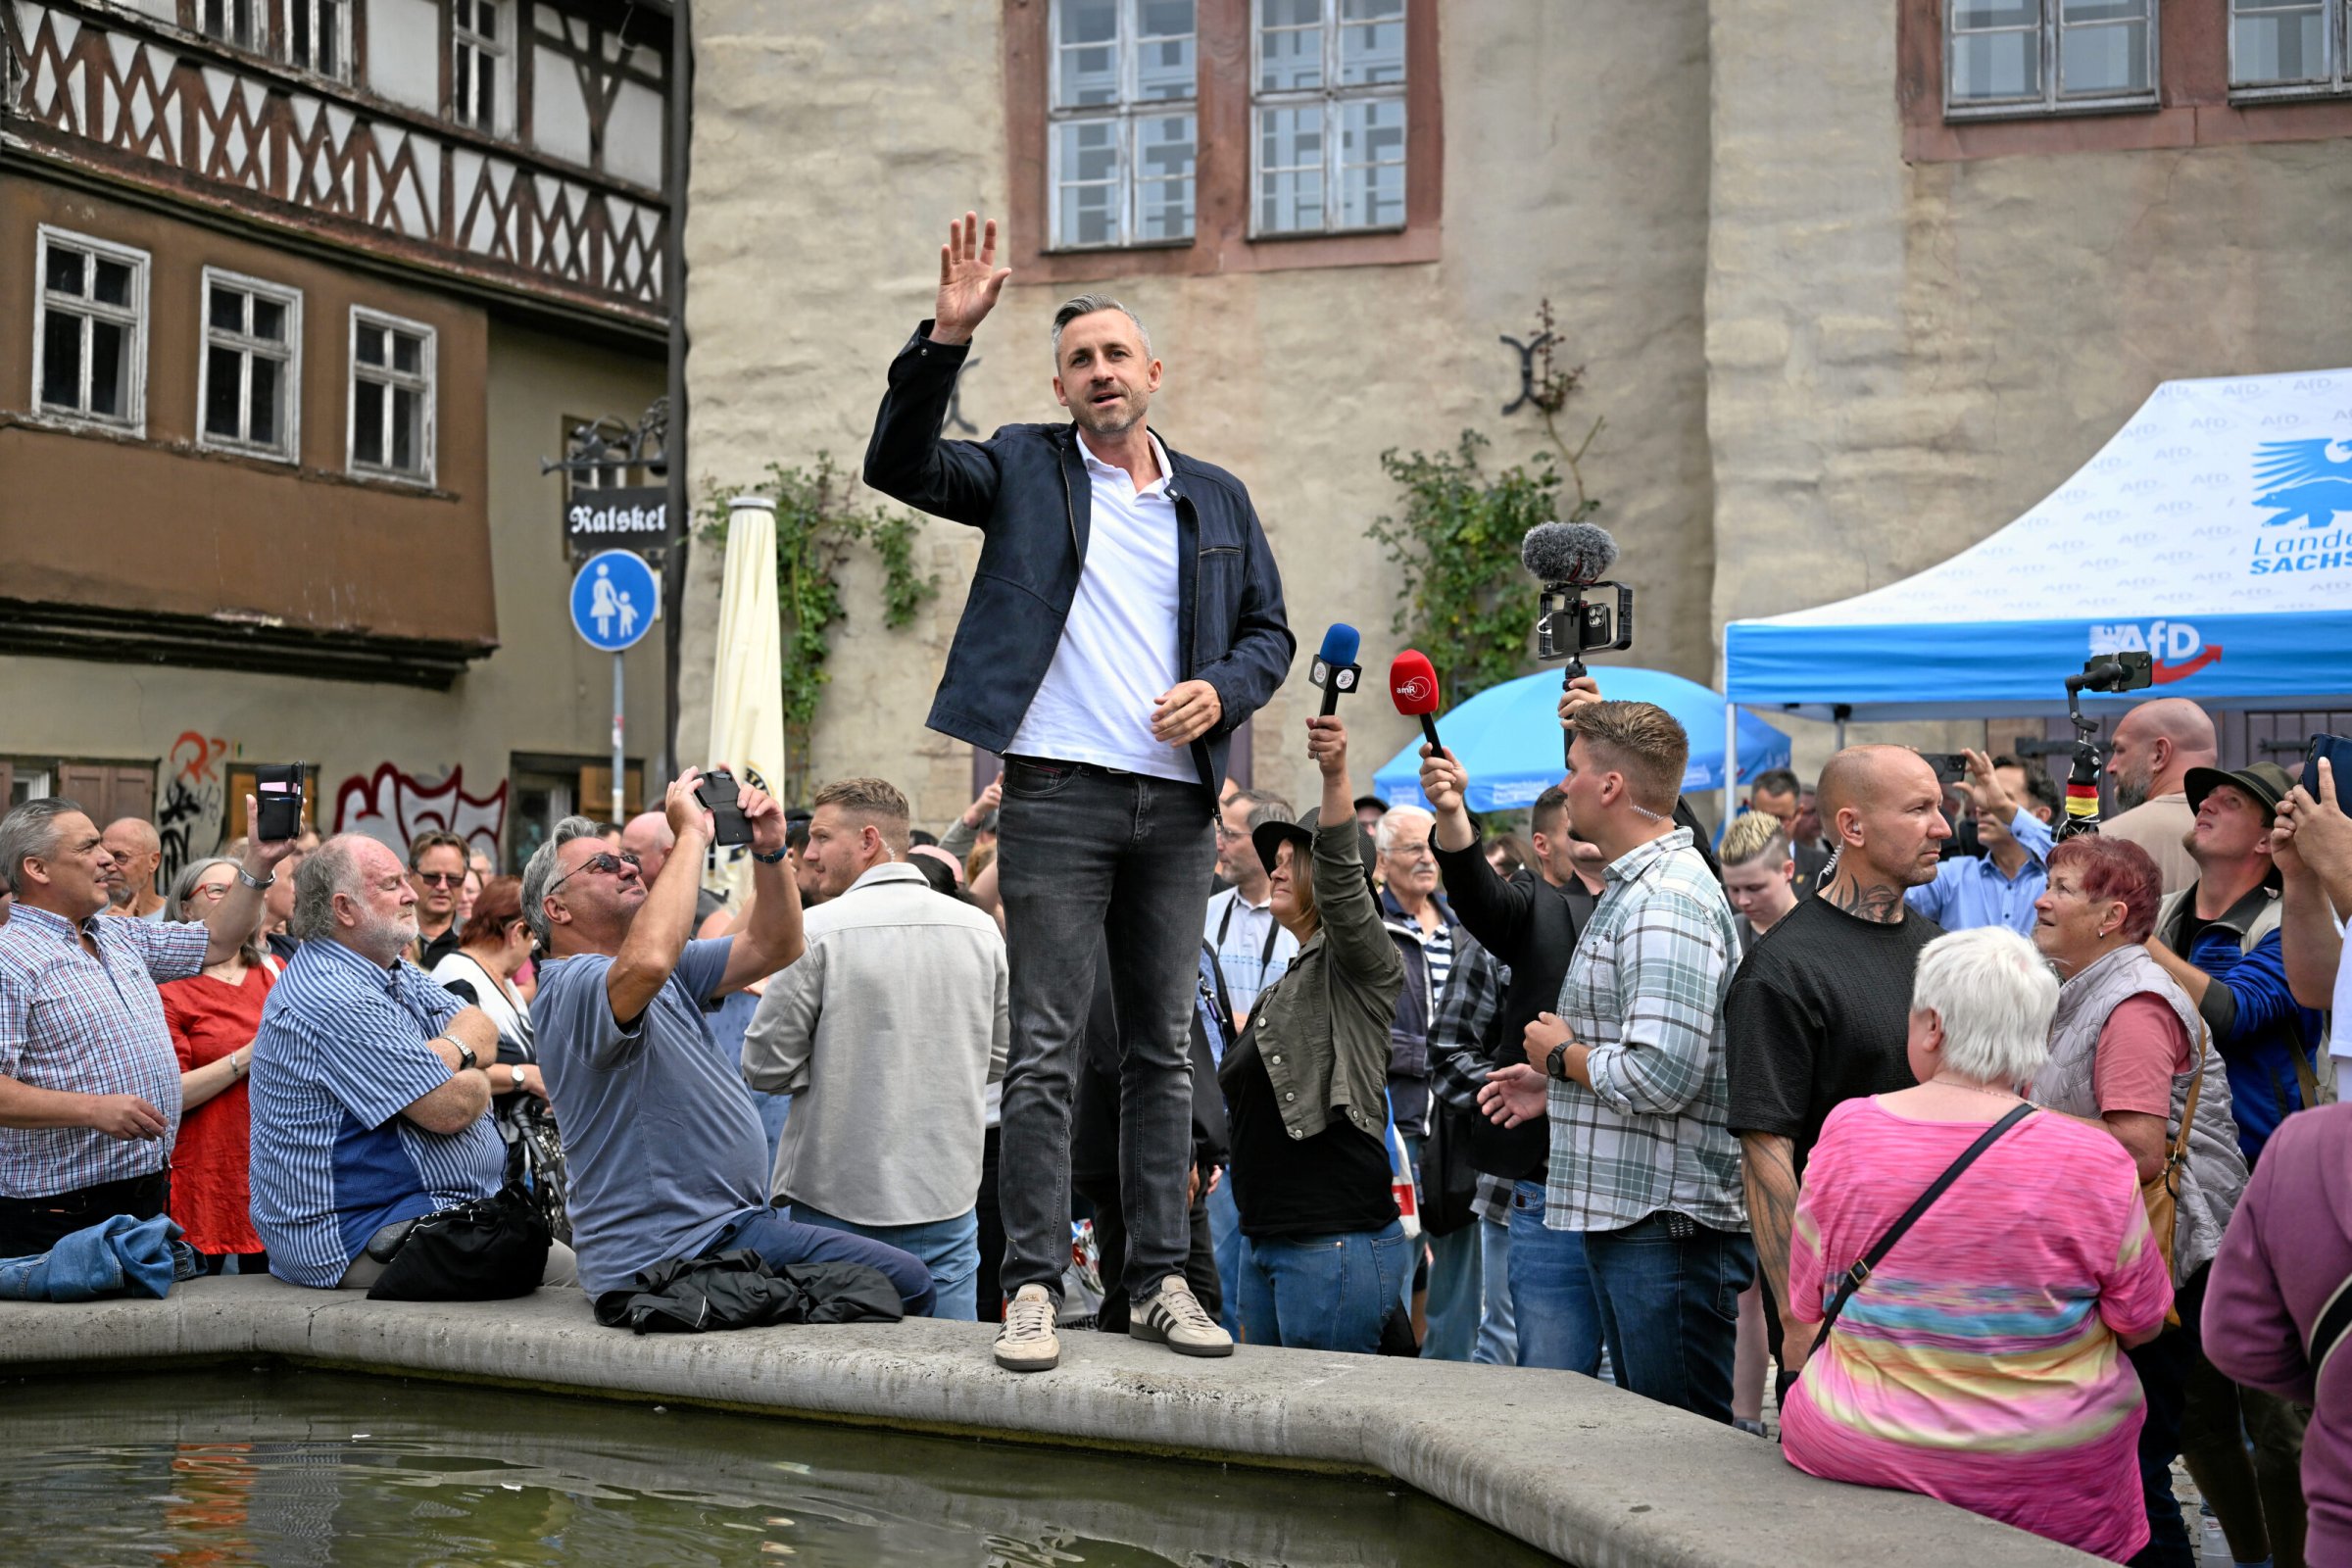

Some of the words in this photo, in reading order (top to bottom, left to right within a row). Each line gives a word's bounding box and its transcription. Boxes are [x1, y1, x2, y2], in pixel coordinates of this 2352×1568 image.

[2293, 377, 2331, 391] AfD
[2189, 416, 2228, 430] AfD
[2260, 414, 2299, 426] AfD
[2154, 447, 2192, 461] AfD
[2190, 473, 2230, 485] AfD
[2119, 479, 2157, 493] AfD
[2154, 501, 2193, 514] AfD
[569, 504, 666, 534] Ratskel
[2082, 509, 2121, 521] AfD
[2190, 525, 2231, 537] AfD
[2118, 532, 2157, 545] AfD
[2046, 540, 2084, 552] AfD
[2079, 557, 2118, 568] AfD
[2152, 551, 2193, 563] AfD
[2191, 571, 2231, 582] AfD
[2119, 619, 2200, 659] AfD
